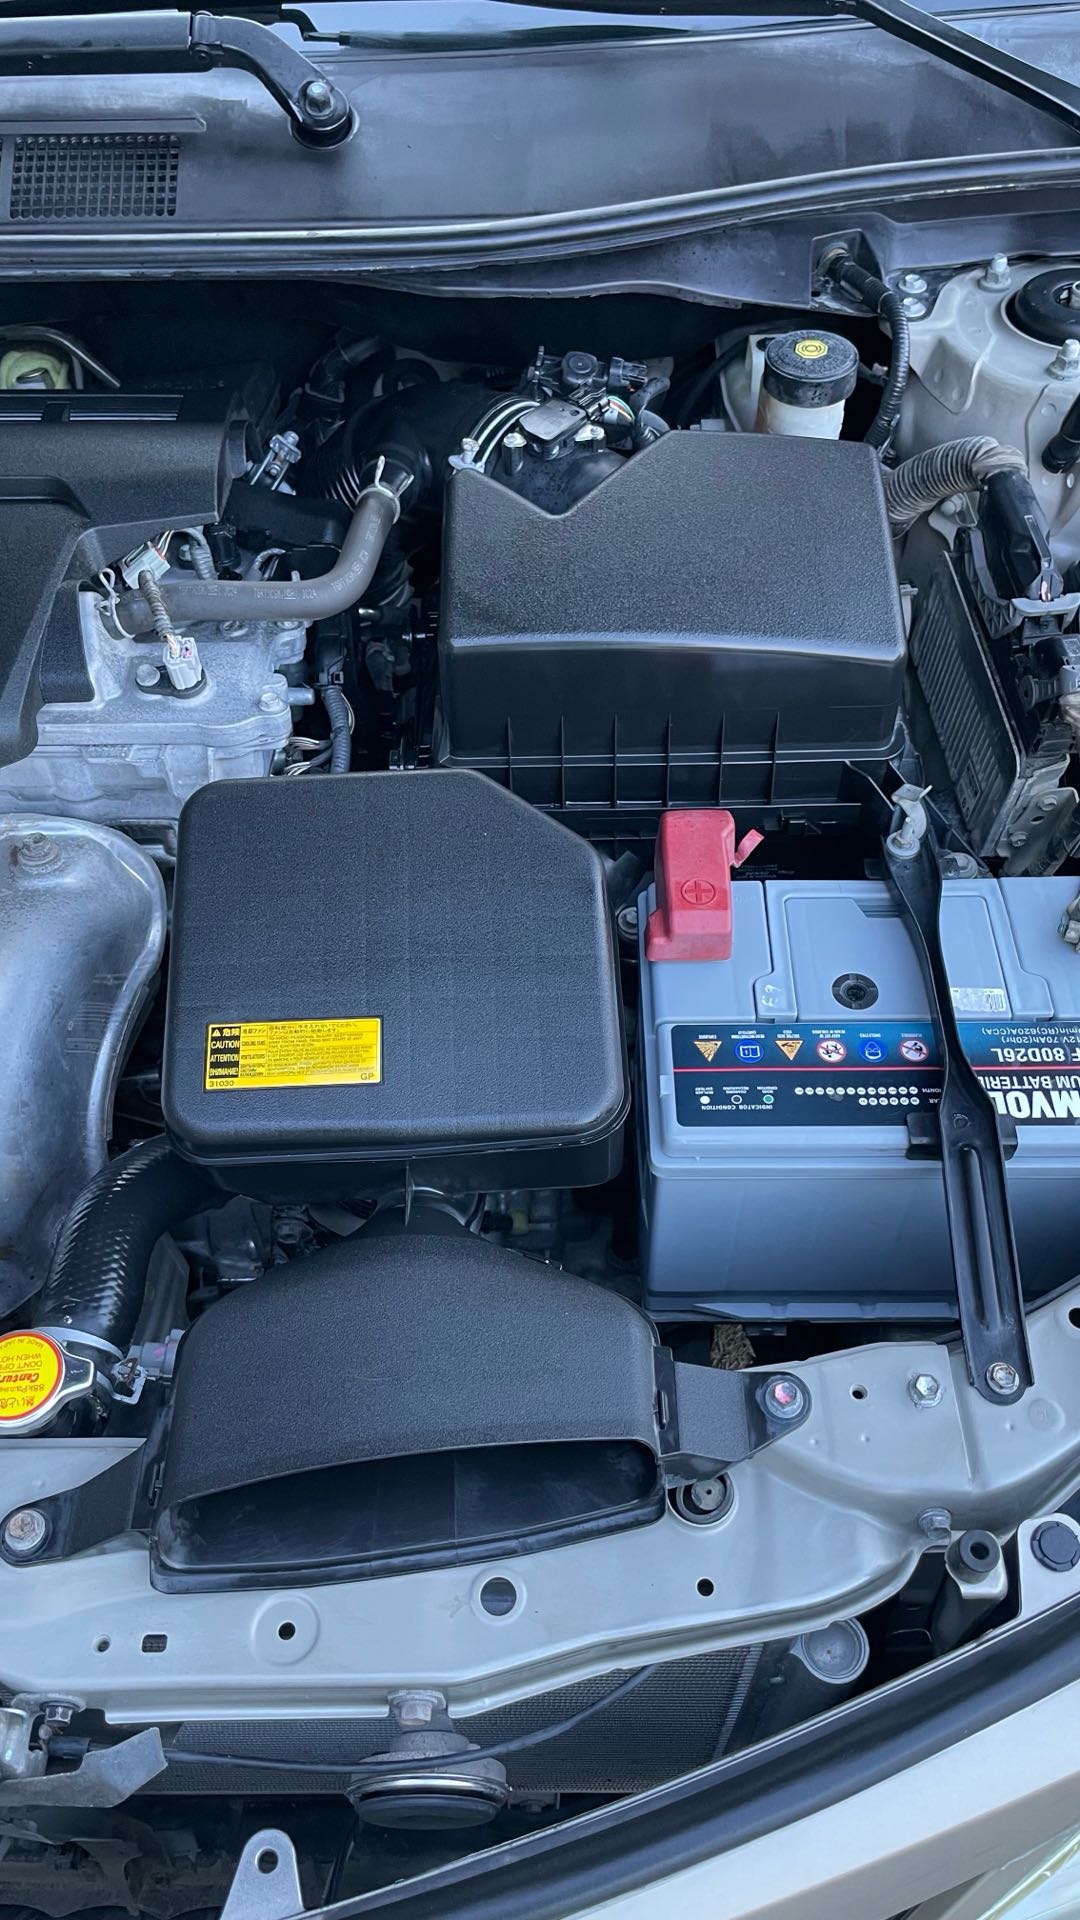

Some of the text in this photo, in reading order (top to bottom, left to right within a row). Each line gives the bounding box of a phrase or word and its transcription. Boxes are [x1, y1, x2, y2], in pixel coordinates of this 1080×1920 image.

[211, 1040, 240, 1049] CAUTION
[1002, 1036, 1080, 1044] 12V 70Ah(20hr)
[210, 1053, 239, 1062] ATTENTION
[990, 1047, 1066, 1062] 80D26L
[360, 1072, 374, 1081] GP
[16, 1361, 42, 1369] DON'T
[0, 1373, 39, 1383] Centur
